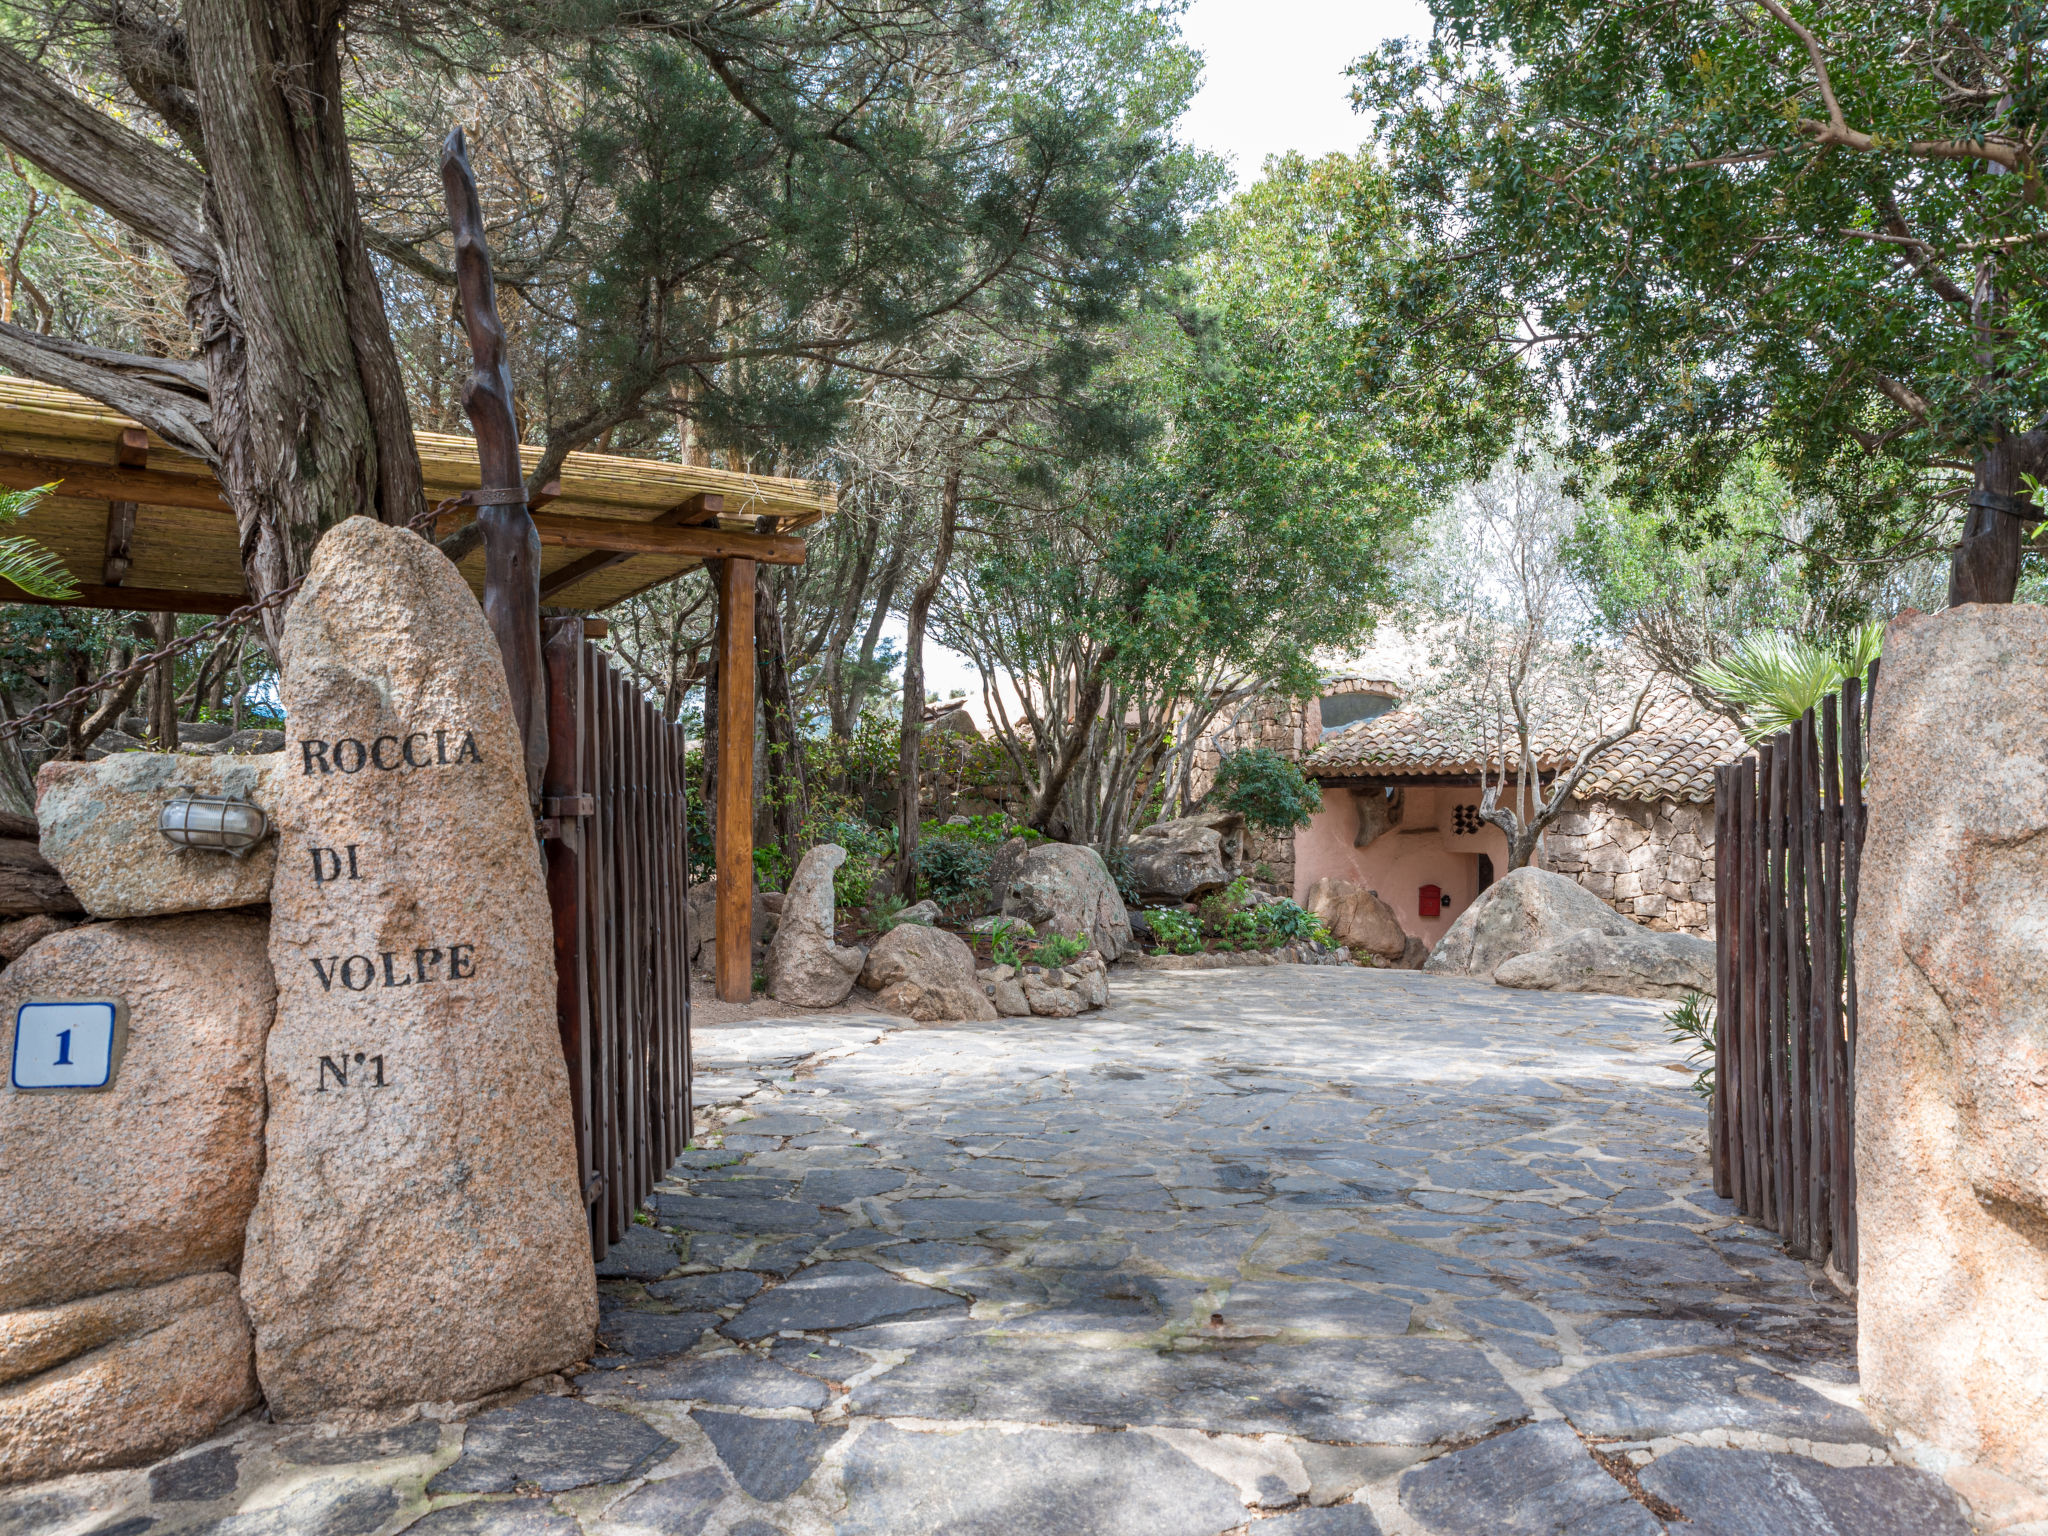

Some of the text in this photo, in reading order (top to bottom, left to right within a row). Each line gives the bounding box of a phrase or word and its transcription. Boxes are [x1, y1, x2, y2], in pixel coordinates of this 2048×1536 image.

[300, 729, 484, 776] ROCCIA
[308, 844, 364, 883] DI
[309, 944, 477, 992] VOLPE
[53, 1028, 74, 1066] 1
